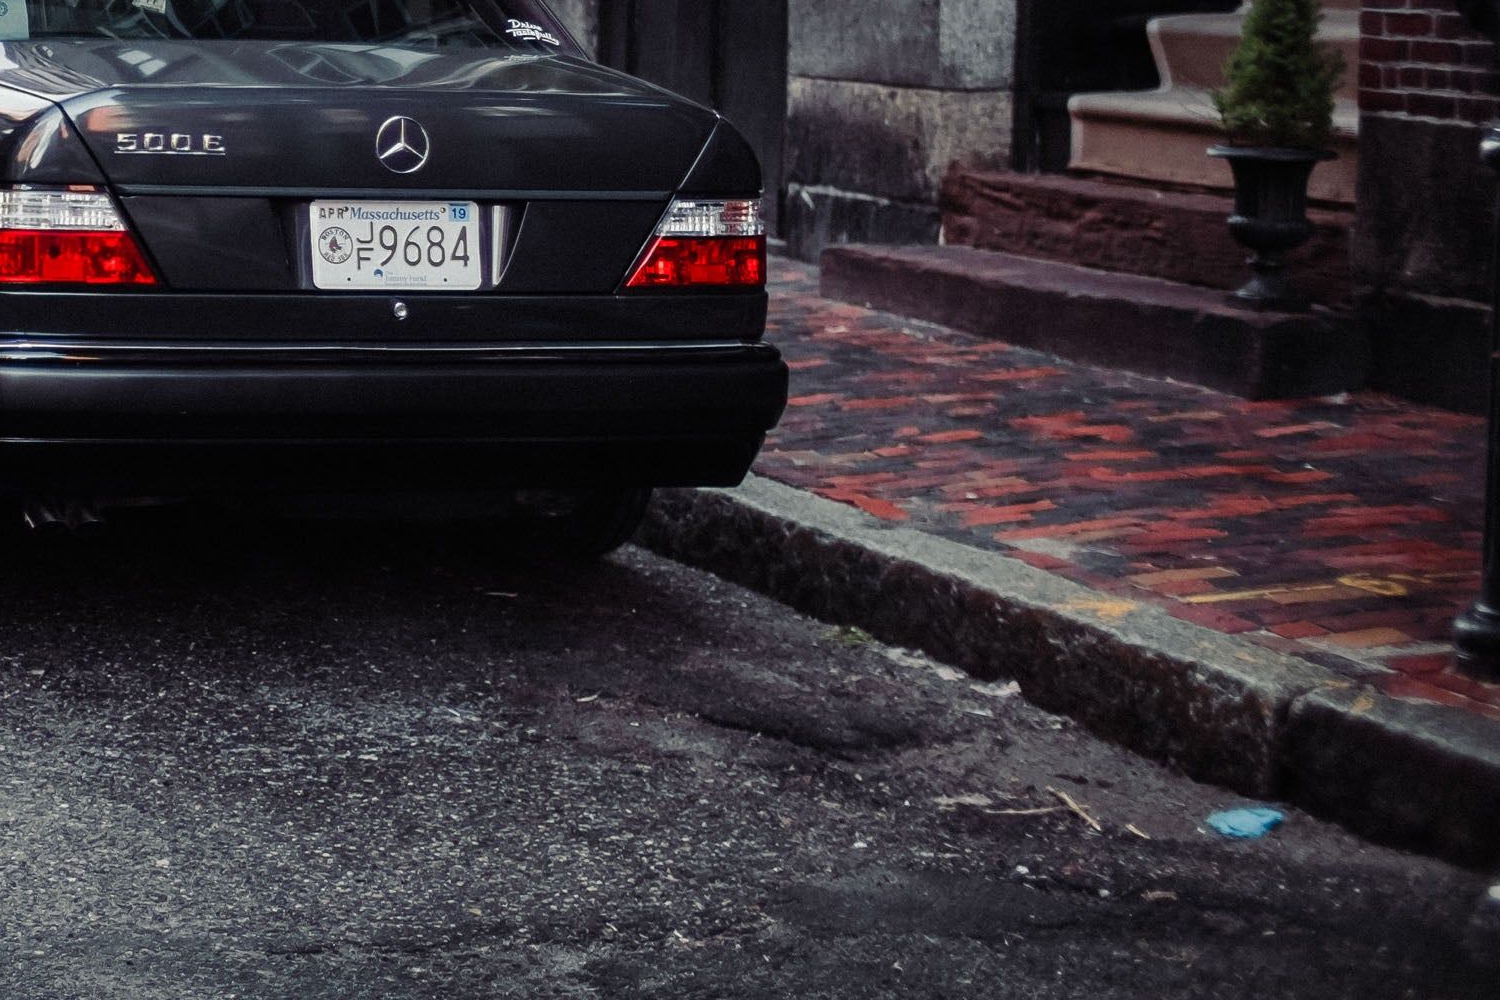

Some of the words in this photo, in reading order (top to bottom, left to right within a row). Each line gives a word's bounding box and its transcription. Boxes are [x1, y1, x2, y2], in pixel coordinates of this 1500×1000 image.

[507, 18, 544, 32] Drive
[116, 132, 191, 151] 500
[202, 133, 226, 152] E
[318, 206, 345, 220] APR
[349, 206, 441, 221] Massachusetts
[451, 207, 467, 220] 19
[321, 229, 350, 241] BOSTON
